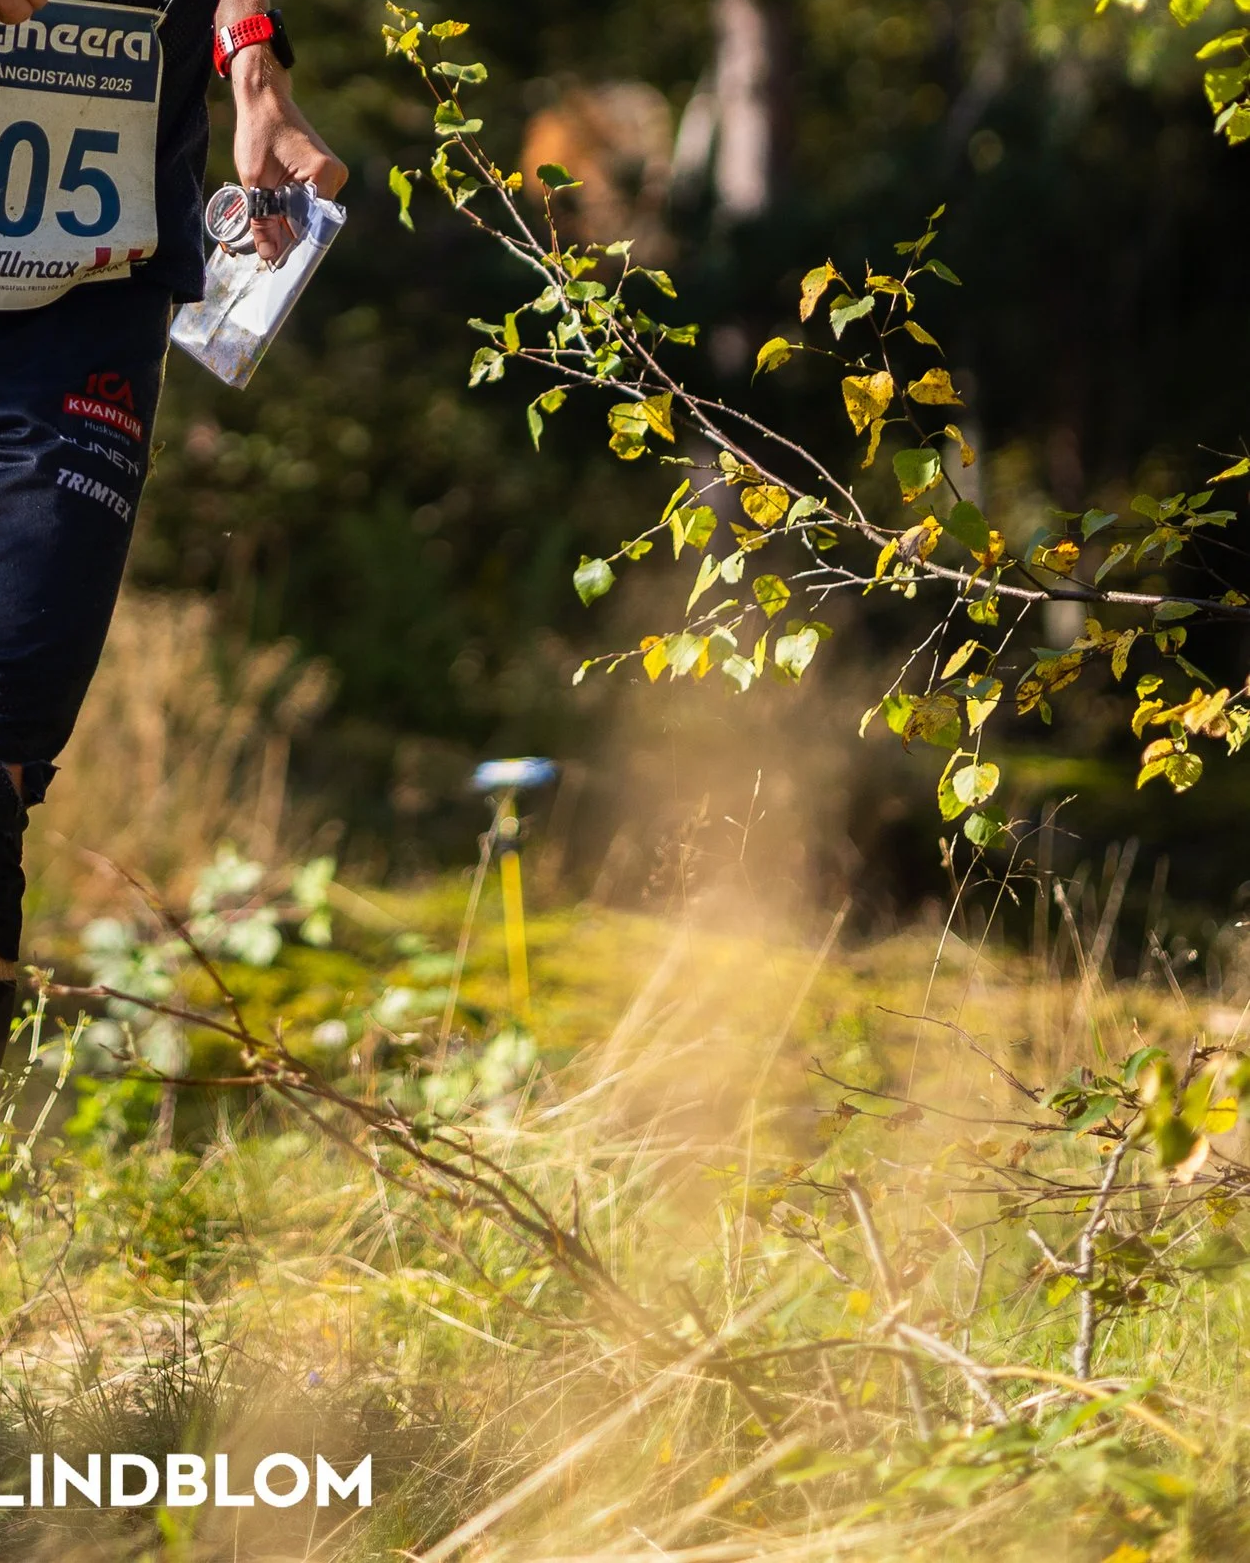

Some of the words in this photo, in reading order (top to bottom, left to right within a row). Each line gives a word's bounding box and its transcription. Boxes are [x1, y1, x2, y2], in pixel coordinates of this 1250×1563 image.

[100, 76, 132, 92] 2025
[86, 373, 134, 411] ICA
[68, 398, 141, 437] KVANTUM
[56, 468, 132, 523] TRIMTEX
